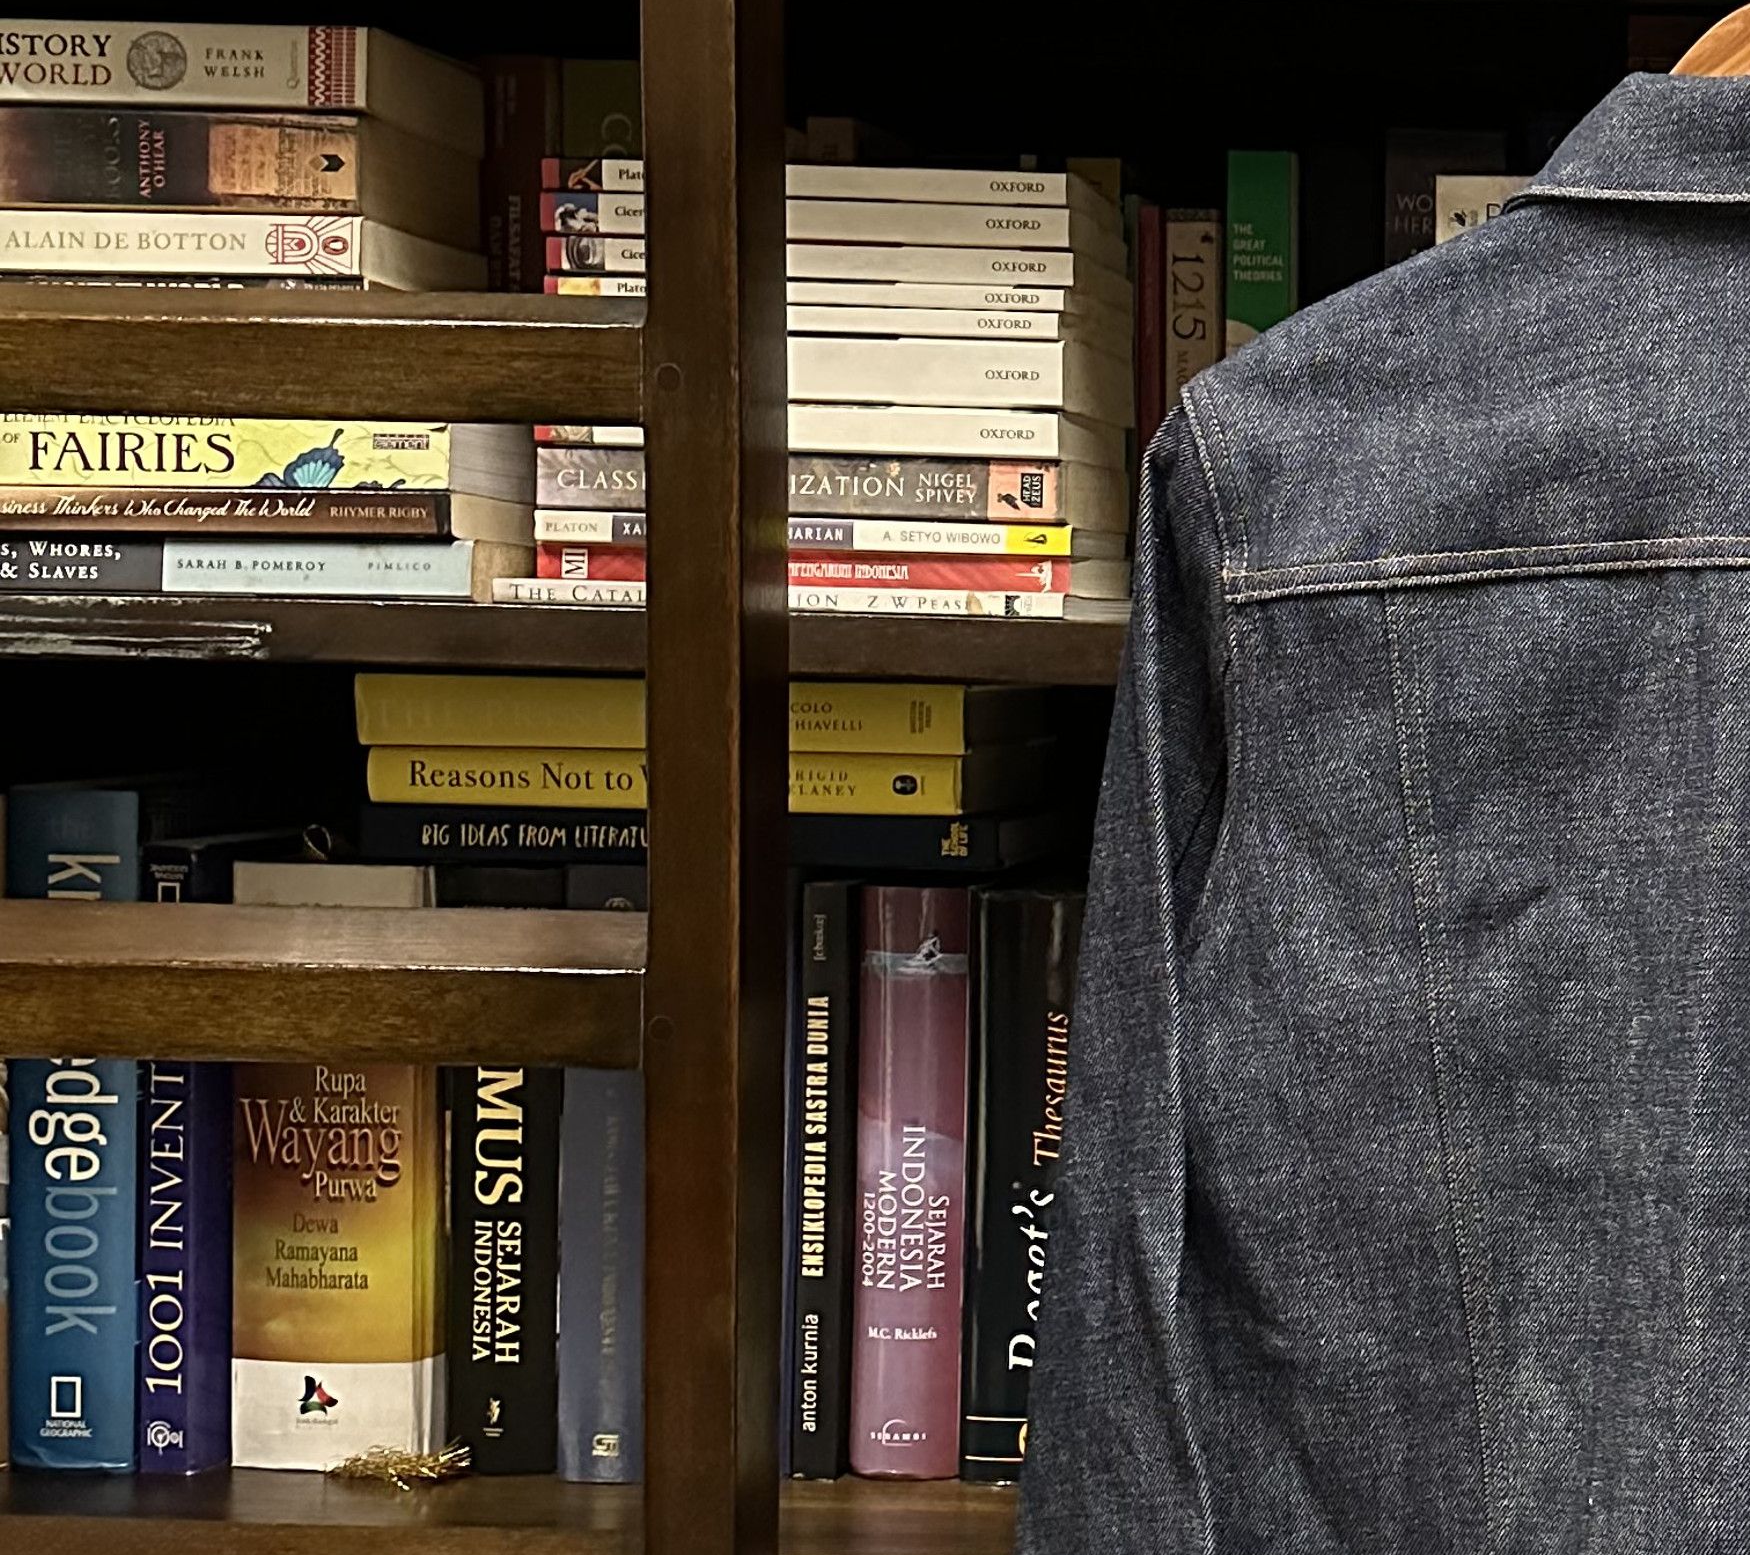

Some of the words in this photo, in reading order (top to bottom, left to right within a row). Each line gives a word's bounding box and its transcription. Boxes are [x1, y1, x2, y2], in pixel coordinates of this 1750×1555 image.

[205, 48, 264, 61] FRANK
[204, 66, 265, 78] WELSH
[990, 181, 1045, 193] OXFORD
[7, 230, 87, 250] ALAIN
[94, 231, 129, 250] DE
[137, 231, 246, 252] BOTTON
[28, 432, 235, 473] FAIRIES
[919, 472, 972, 488] NIGEL
[916, 487, 977, 505] SPIVEY
[409, 760, 531, 789] Reasons
[541, 762, 594, 791] Not
[602, 766, 634, 792] to
[807, 996, 828, 1055] DUNIA
[805, 1062, 828, 1135] SASTRA
[241, 1098, 402, 1185] Wayang
[313, 1172, 378, 1202] Purwa
[801, 1141, 826, 1277] ENSIKLOPEDIA
[276, 1241, 358, 1266] Ramayana
[266, 1267, 368, 1293] Mahabharata
[470, 1220, 494, 1363] INDONESIA
[495, 1220, 523, 1364] SEJARAH
